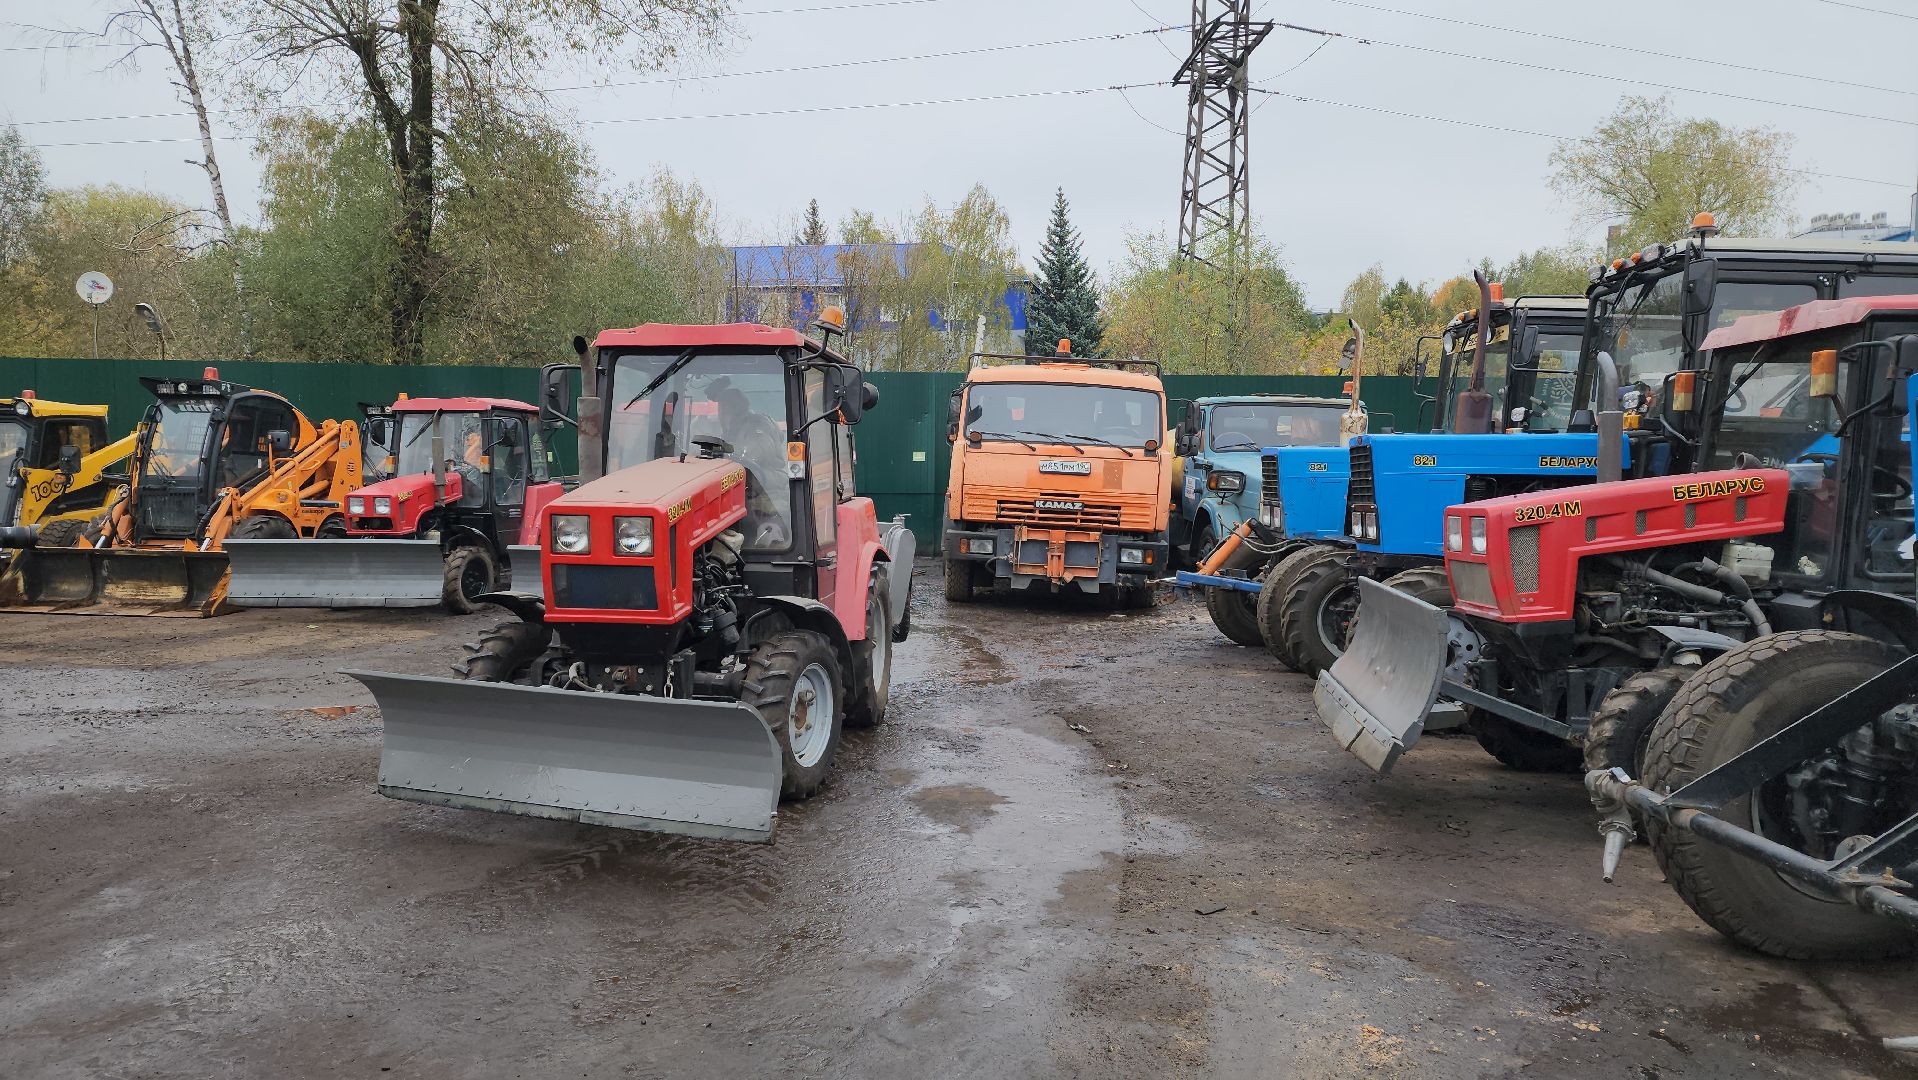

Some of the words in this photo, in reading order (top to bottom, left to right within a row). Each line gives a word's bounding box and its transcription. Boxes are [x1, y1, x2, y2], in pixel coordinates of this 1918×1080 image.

[1413, 455, 1437, 467] 82.1
[1673, 477, 1764, 501] БЕЛАРУС
[1035, 500, 1083, 510] KAMAZ
